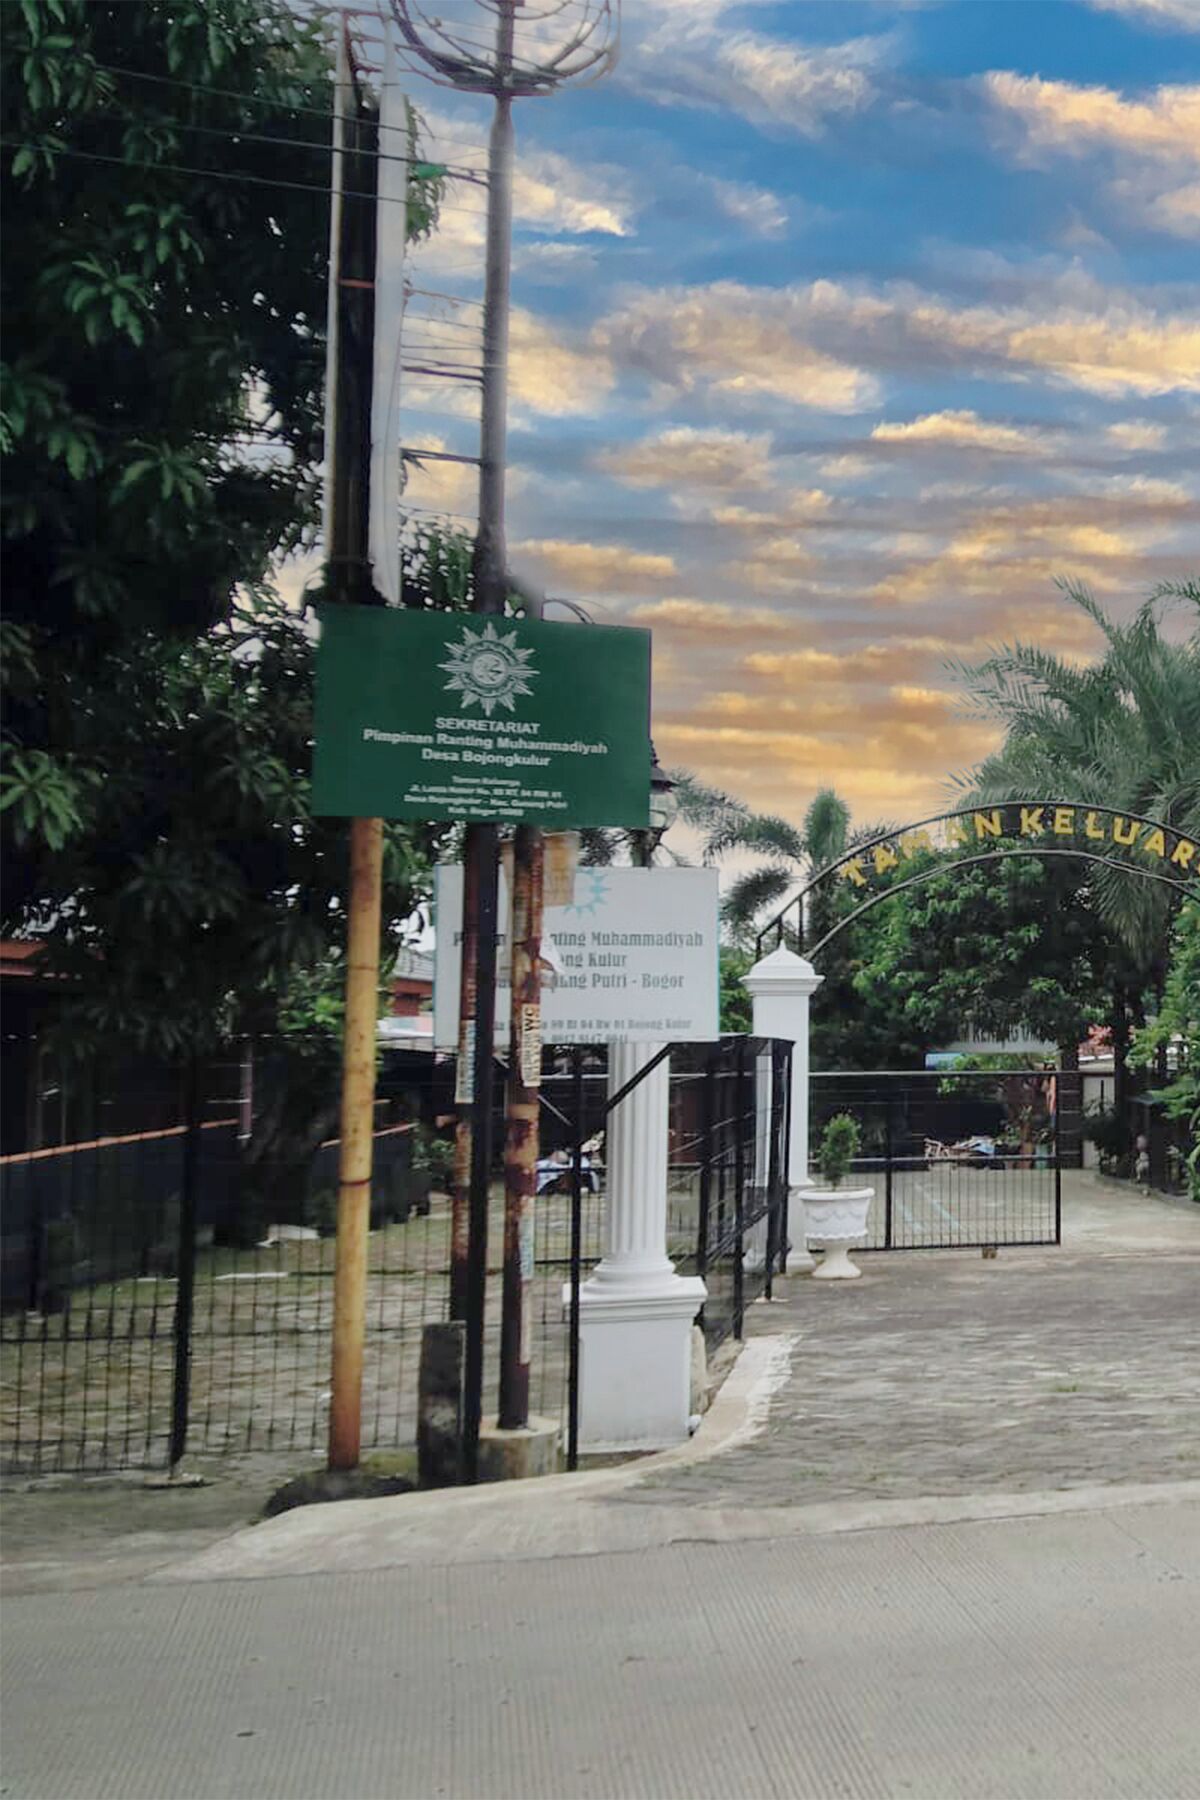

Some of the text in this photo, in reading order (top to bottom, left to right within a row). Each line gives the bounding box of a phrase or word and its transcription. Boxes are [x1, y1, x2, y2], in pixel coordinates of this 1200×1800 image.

[435, 717, 541, 734] SEKRETARIAT
[363, 728, 608, 755] Pimpinan Ranting Muhammadiyah
[421, 747, 552, 768] Desa Bojongkulur
[840, 810, 1003, 888] TAMAN
[591, 931, 704, 947] Muhammadiyah
[588, 951, 627, 967] Kulur
[591, 973, 628, 988] Putri
[641, 973, 685, 989] Bogor
